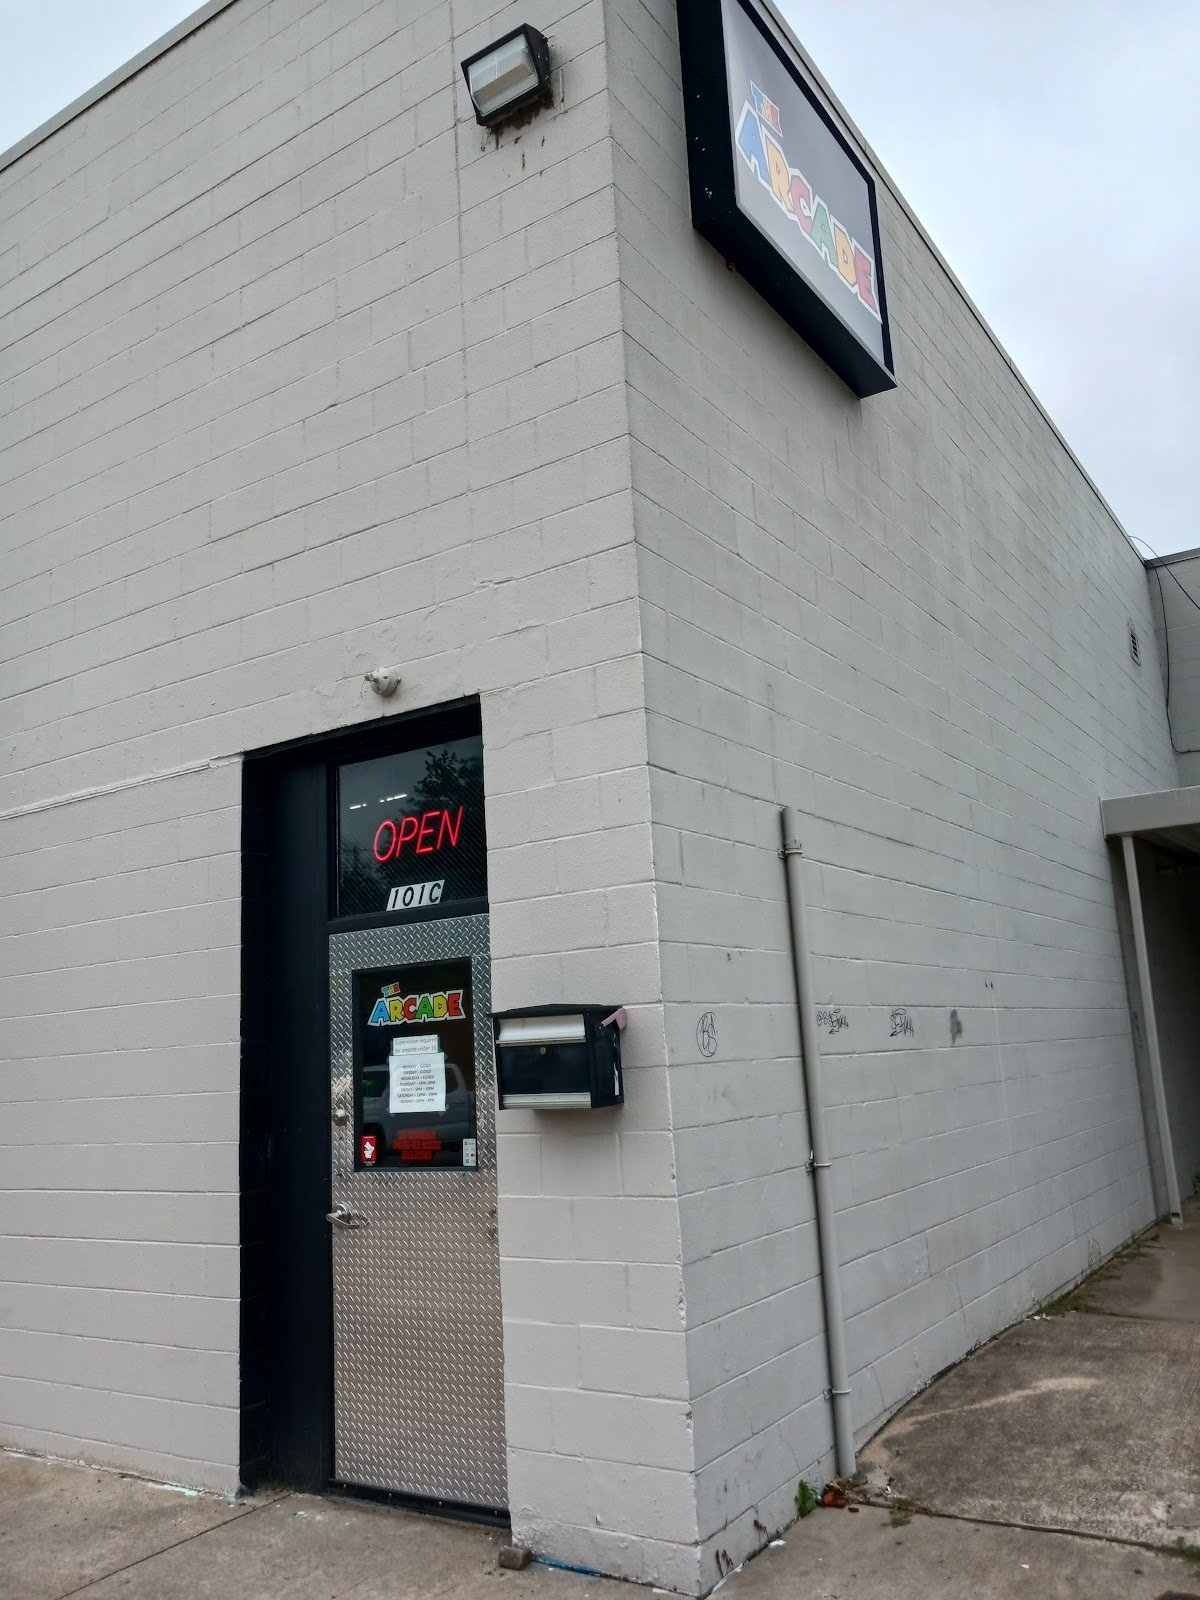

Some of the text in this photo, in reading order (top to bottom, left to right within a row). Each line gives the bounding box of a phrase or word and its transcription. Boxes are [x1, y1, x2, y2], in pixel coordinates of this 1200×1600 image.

[750, 80, 783, 138] THE
[735, 101, 882, 323] ARCADE
[374, 806, 464, 862] OPEN
[391, 882, 442, 909] 101C
[367, 989, 466, 1027] ARCADE
